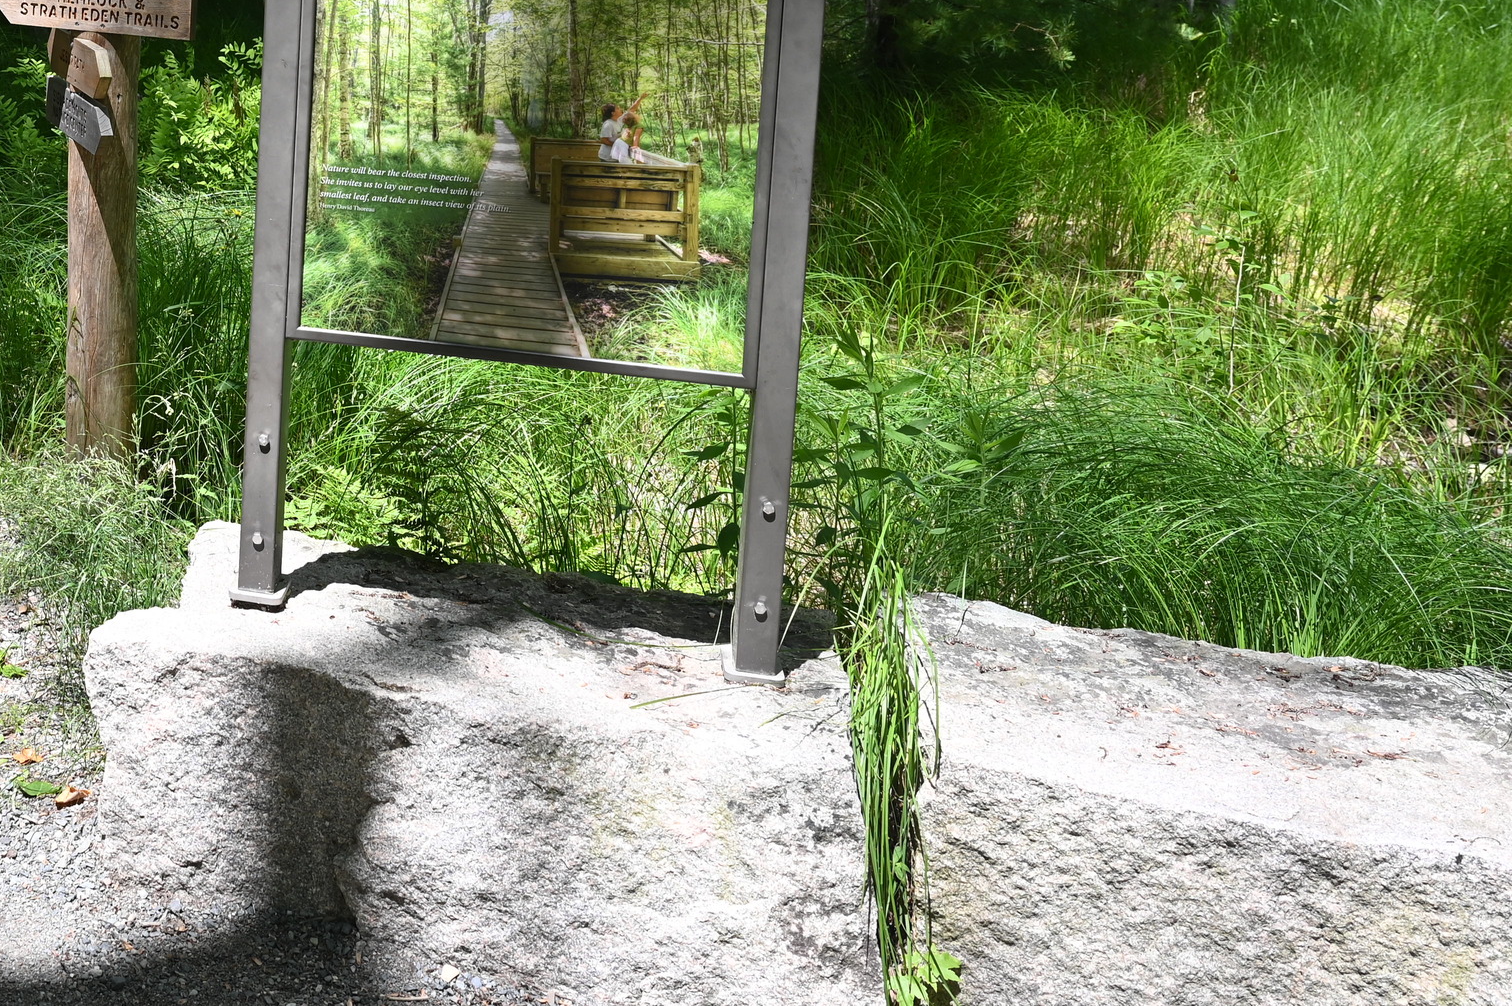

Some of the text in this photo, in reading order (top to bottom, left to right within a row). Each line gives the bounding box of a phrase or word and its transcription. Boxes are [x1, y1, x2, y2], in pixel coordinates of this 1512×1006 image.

[20, 2, 180, 29] STRATH EDEN TRAILS
[322, 164, 471, 184] Nature will bear the closest inspection.
[320, 176, 334, 185] She
[336, 178, 362, 187] invites
[374, 181, 382, 189] to
[383, 181, 397, 191] lay
[414, 186, 428, 194] eye
[429, 185, 448, 194] level
[449, 186, 468, 195] with
[469, 188, 484, 196] her
[320, 189, 352, 199] smallest
[352, 192, 369, 202] leaf,
[371, 193, 388, 202] and
[388, 195, 406, 204] take
[420, 198, 444, 207] insect
[444, 200, 465, 208] view
[466, 201, 474, 211] of
[475, 202, 485, 210] its
[487, 203, 511, 214] plain.
